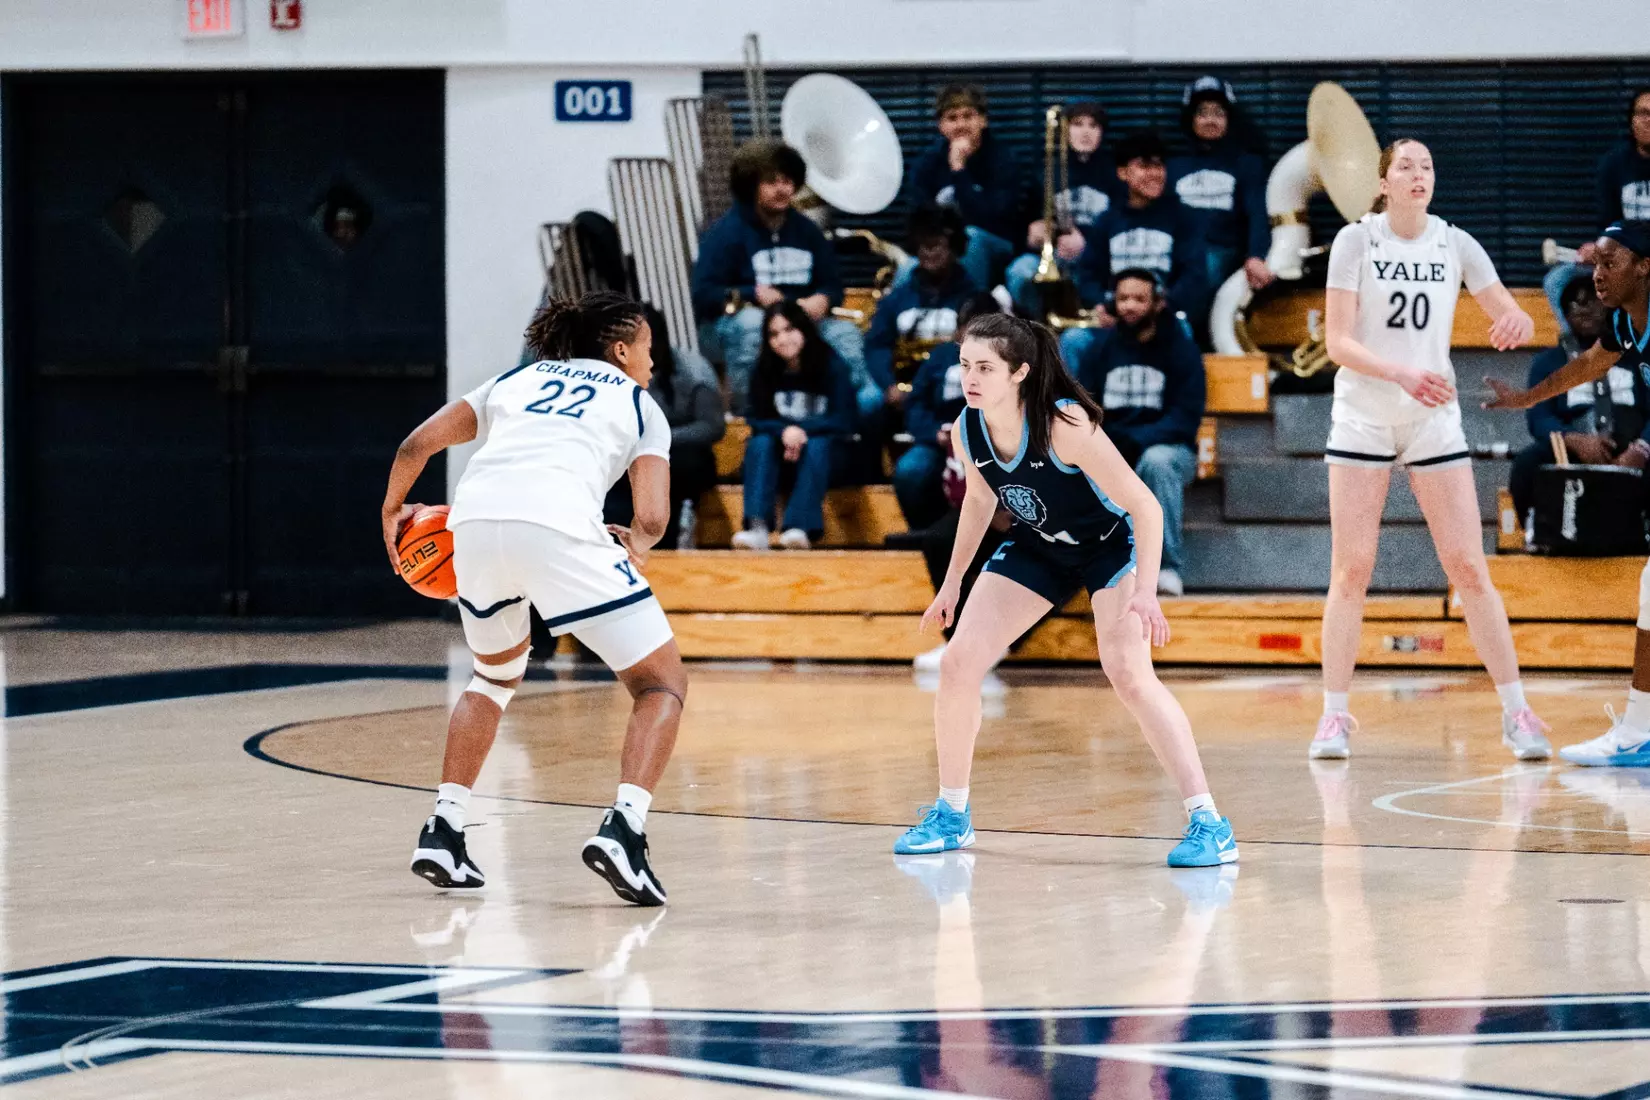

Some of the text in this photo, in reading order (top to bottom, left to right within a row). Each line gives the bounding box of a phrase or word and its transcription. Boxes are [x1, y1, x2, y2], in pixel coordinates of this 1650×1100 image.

[564, 86, 623, 115] 001
[1373, 260, 1445, 281] YALE
[1387, 291, 1430, 330] 20
[536, 362, 626, 385] CHAPMAN
[524, 380, 596, 418] 22
[400, 541, 438, 574] ELITE
[615, 560, 637, 586] Y
